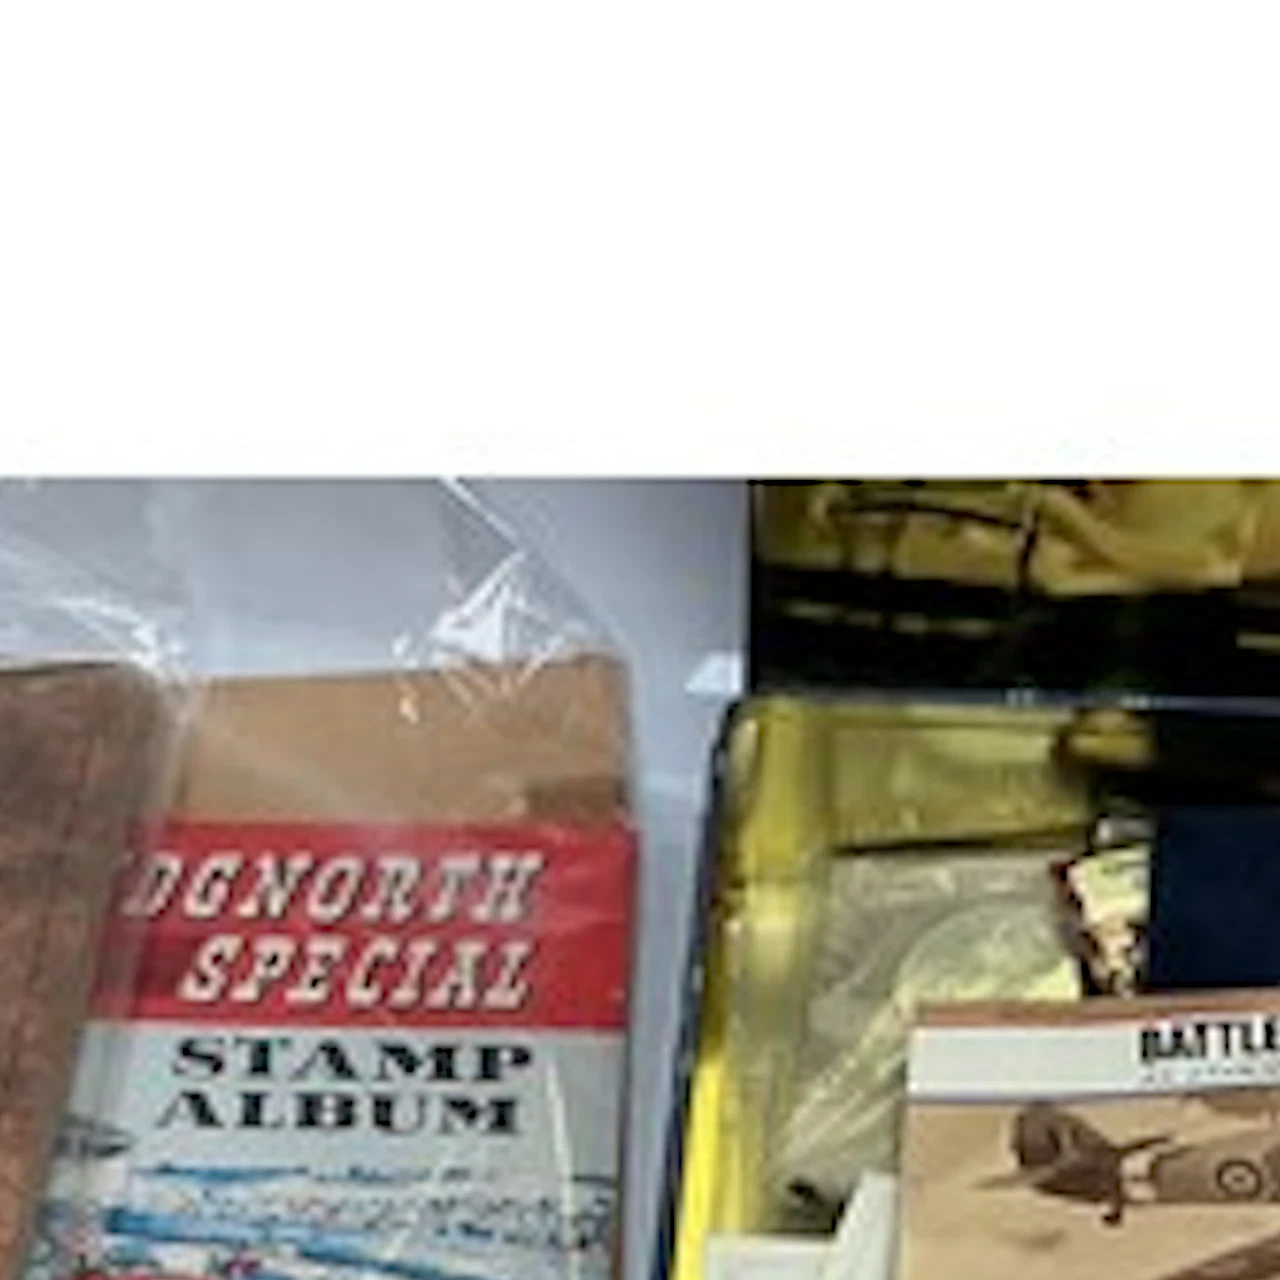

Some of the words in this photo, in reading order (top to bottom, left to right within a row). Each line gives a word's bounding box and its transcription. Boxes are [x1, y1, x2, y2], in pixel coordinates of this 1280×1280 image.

[176, 932, 534, 1012] SPECIAL
[171, 1035, 536, 1085] STAMP
[154, 1090, 522, 1136] ALBUM
